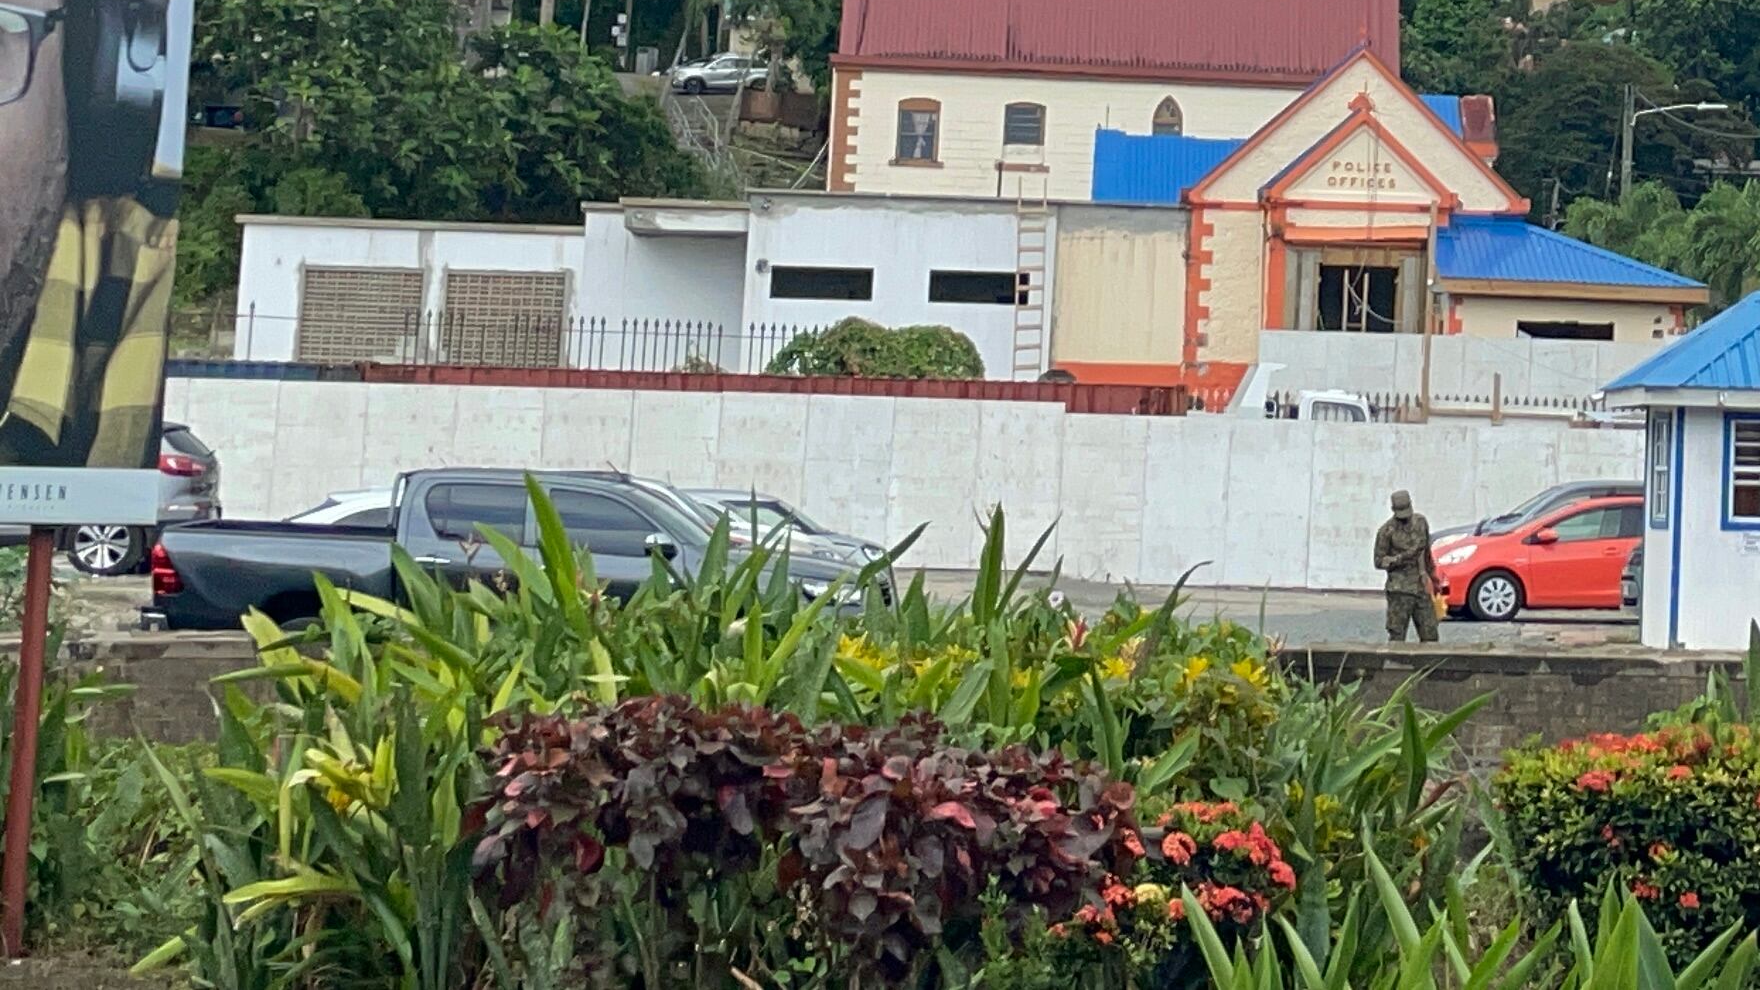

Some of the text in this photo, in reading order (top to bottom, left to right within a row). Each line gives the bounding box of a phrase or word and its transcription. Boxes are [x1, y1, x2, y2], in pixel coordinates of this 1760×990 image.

[1332, 160, 1392, 174] POLICE
[1327, 176, 1397, 189] OFFICES
[0, 483, 67, 501] ENSEN
